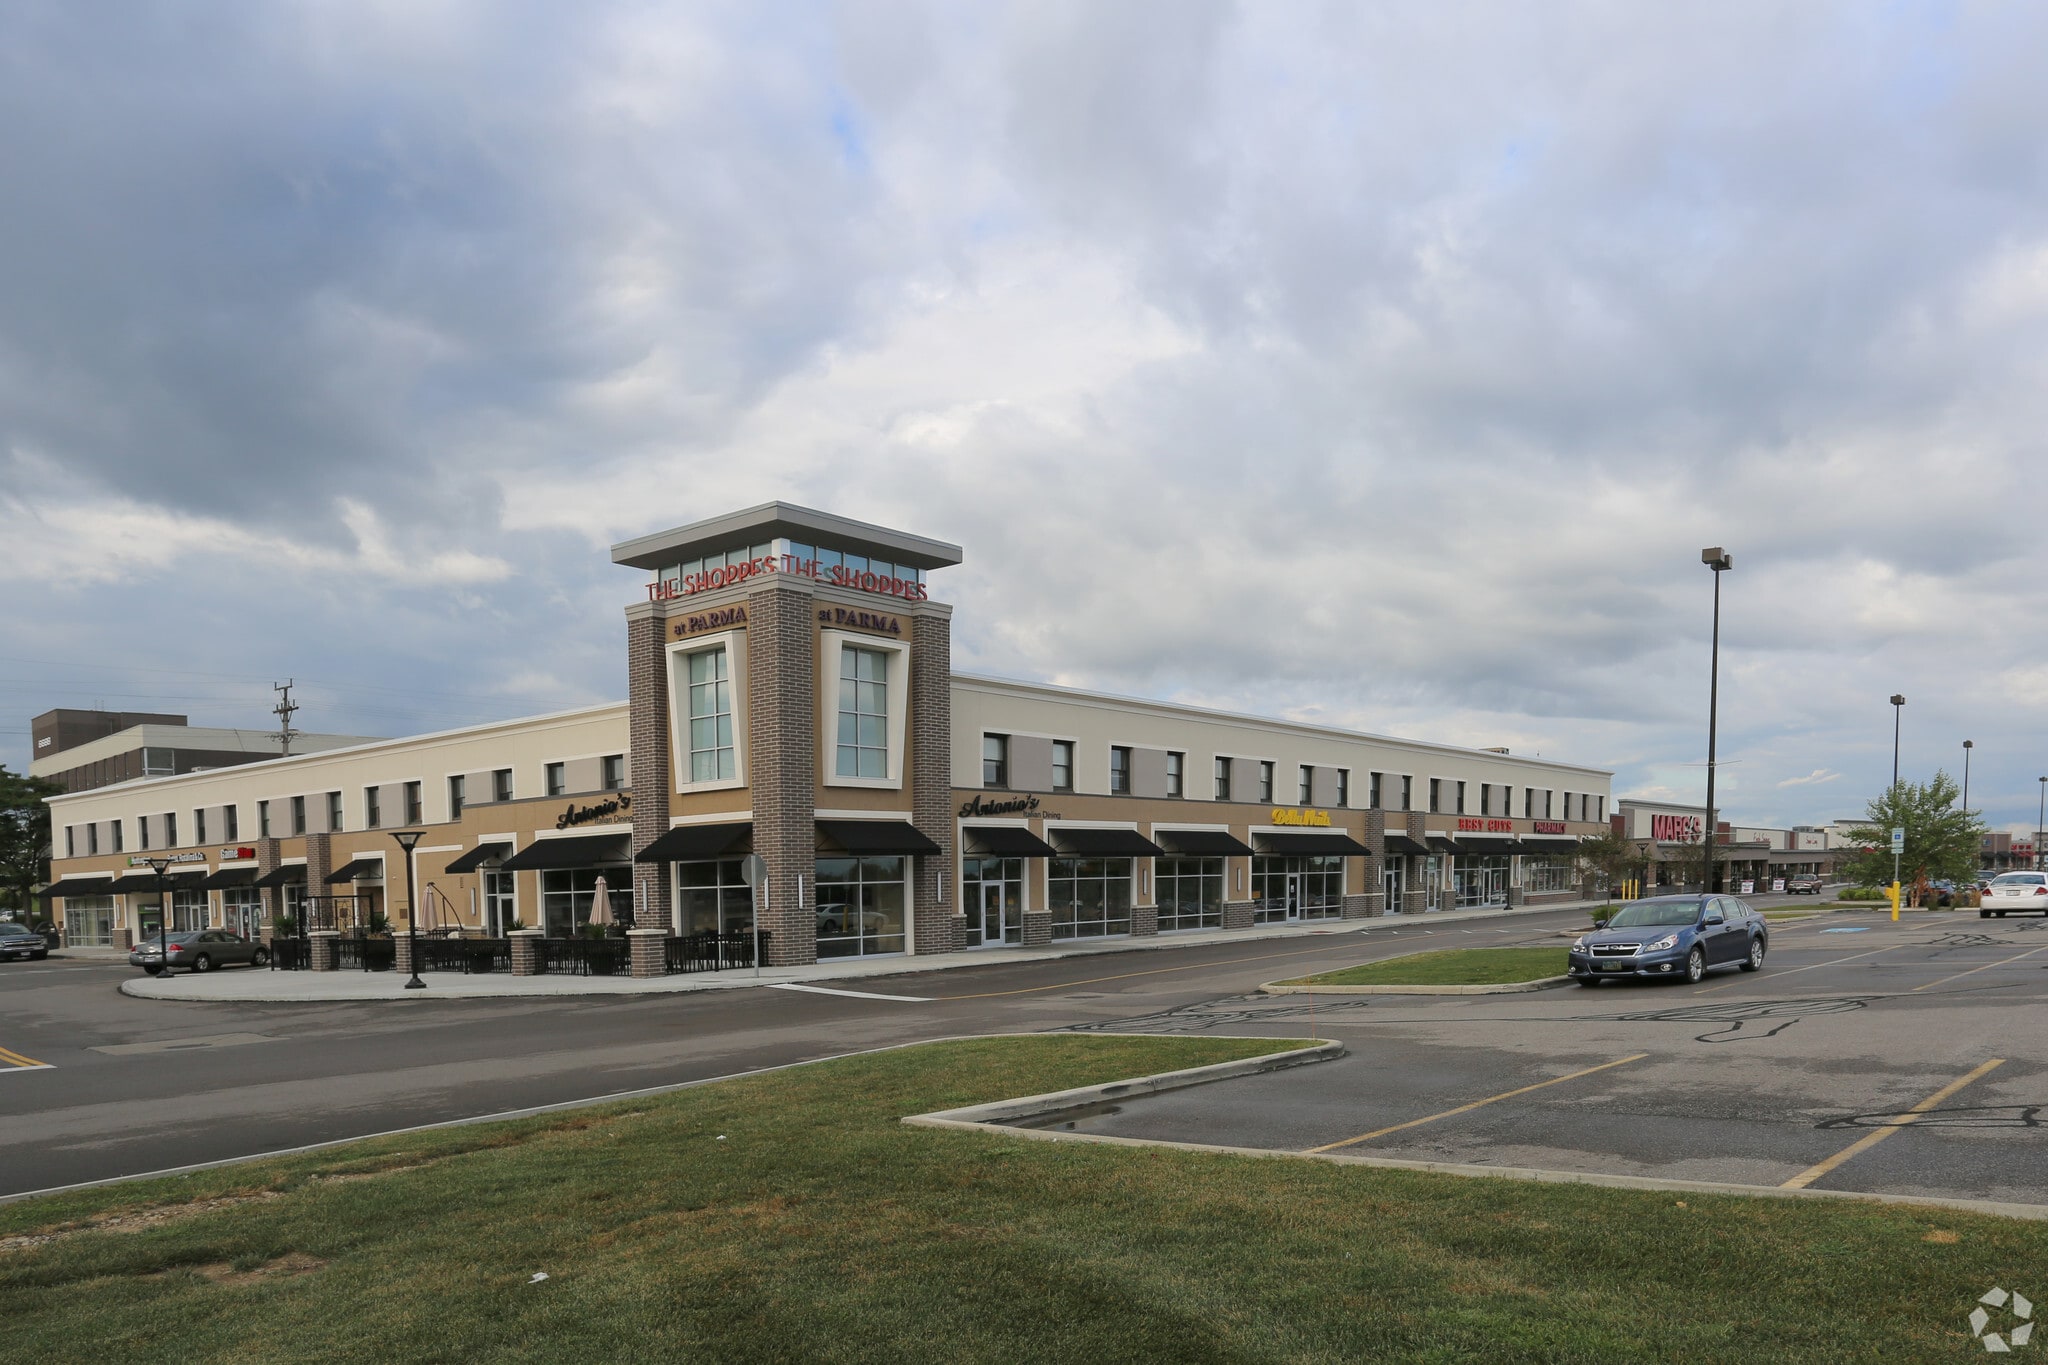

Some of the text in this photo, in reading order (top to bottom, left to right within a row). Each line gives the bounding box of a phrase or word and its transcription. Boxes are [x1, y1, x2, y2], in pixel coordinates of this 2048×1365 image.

[645, 555, 777, 600] THE SHOPPES
[782, 554, 928, 601] THE SHOPPES
[674, 606, 747, 635] at PARMA
[819, 607, 901, 633] at PARMA
[556, 793, 631, 829] Antonio's
[959, 793, 1040, 817] Antonio's
[1043, 811, 1061, 819] Dining
[595, 814, 633, 824] Italian Dining
[1458, 818, 1512, 832] BEST CUTS
[1534, 822, 1566, 834] PHARMACY
[1652, 814, 1701, 842] MARC'S
[221, 847, 255, 859] Game
